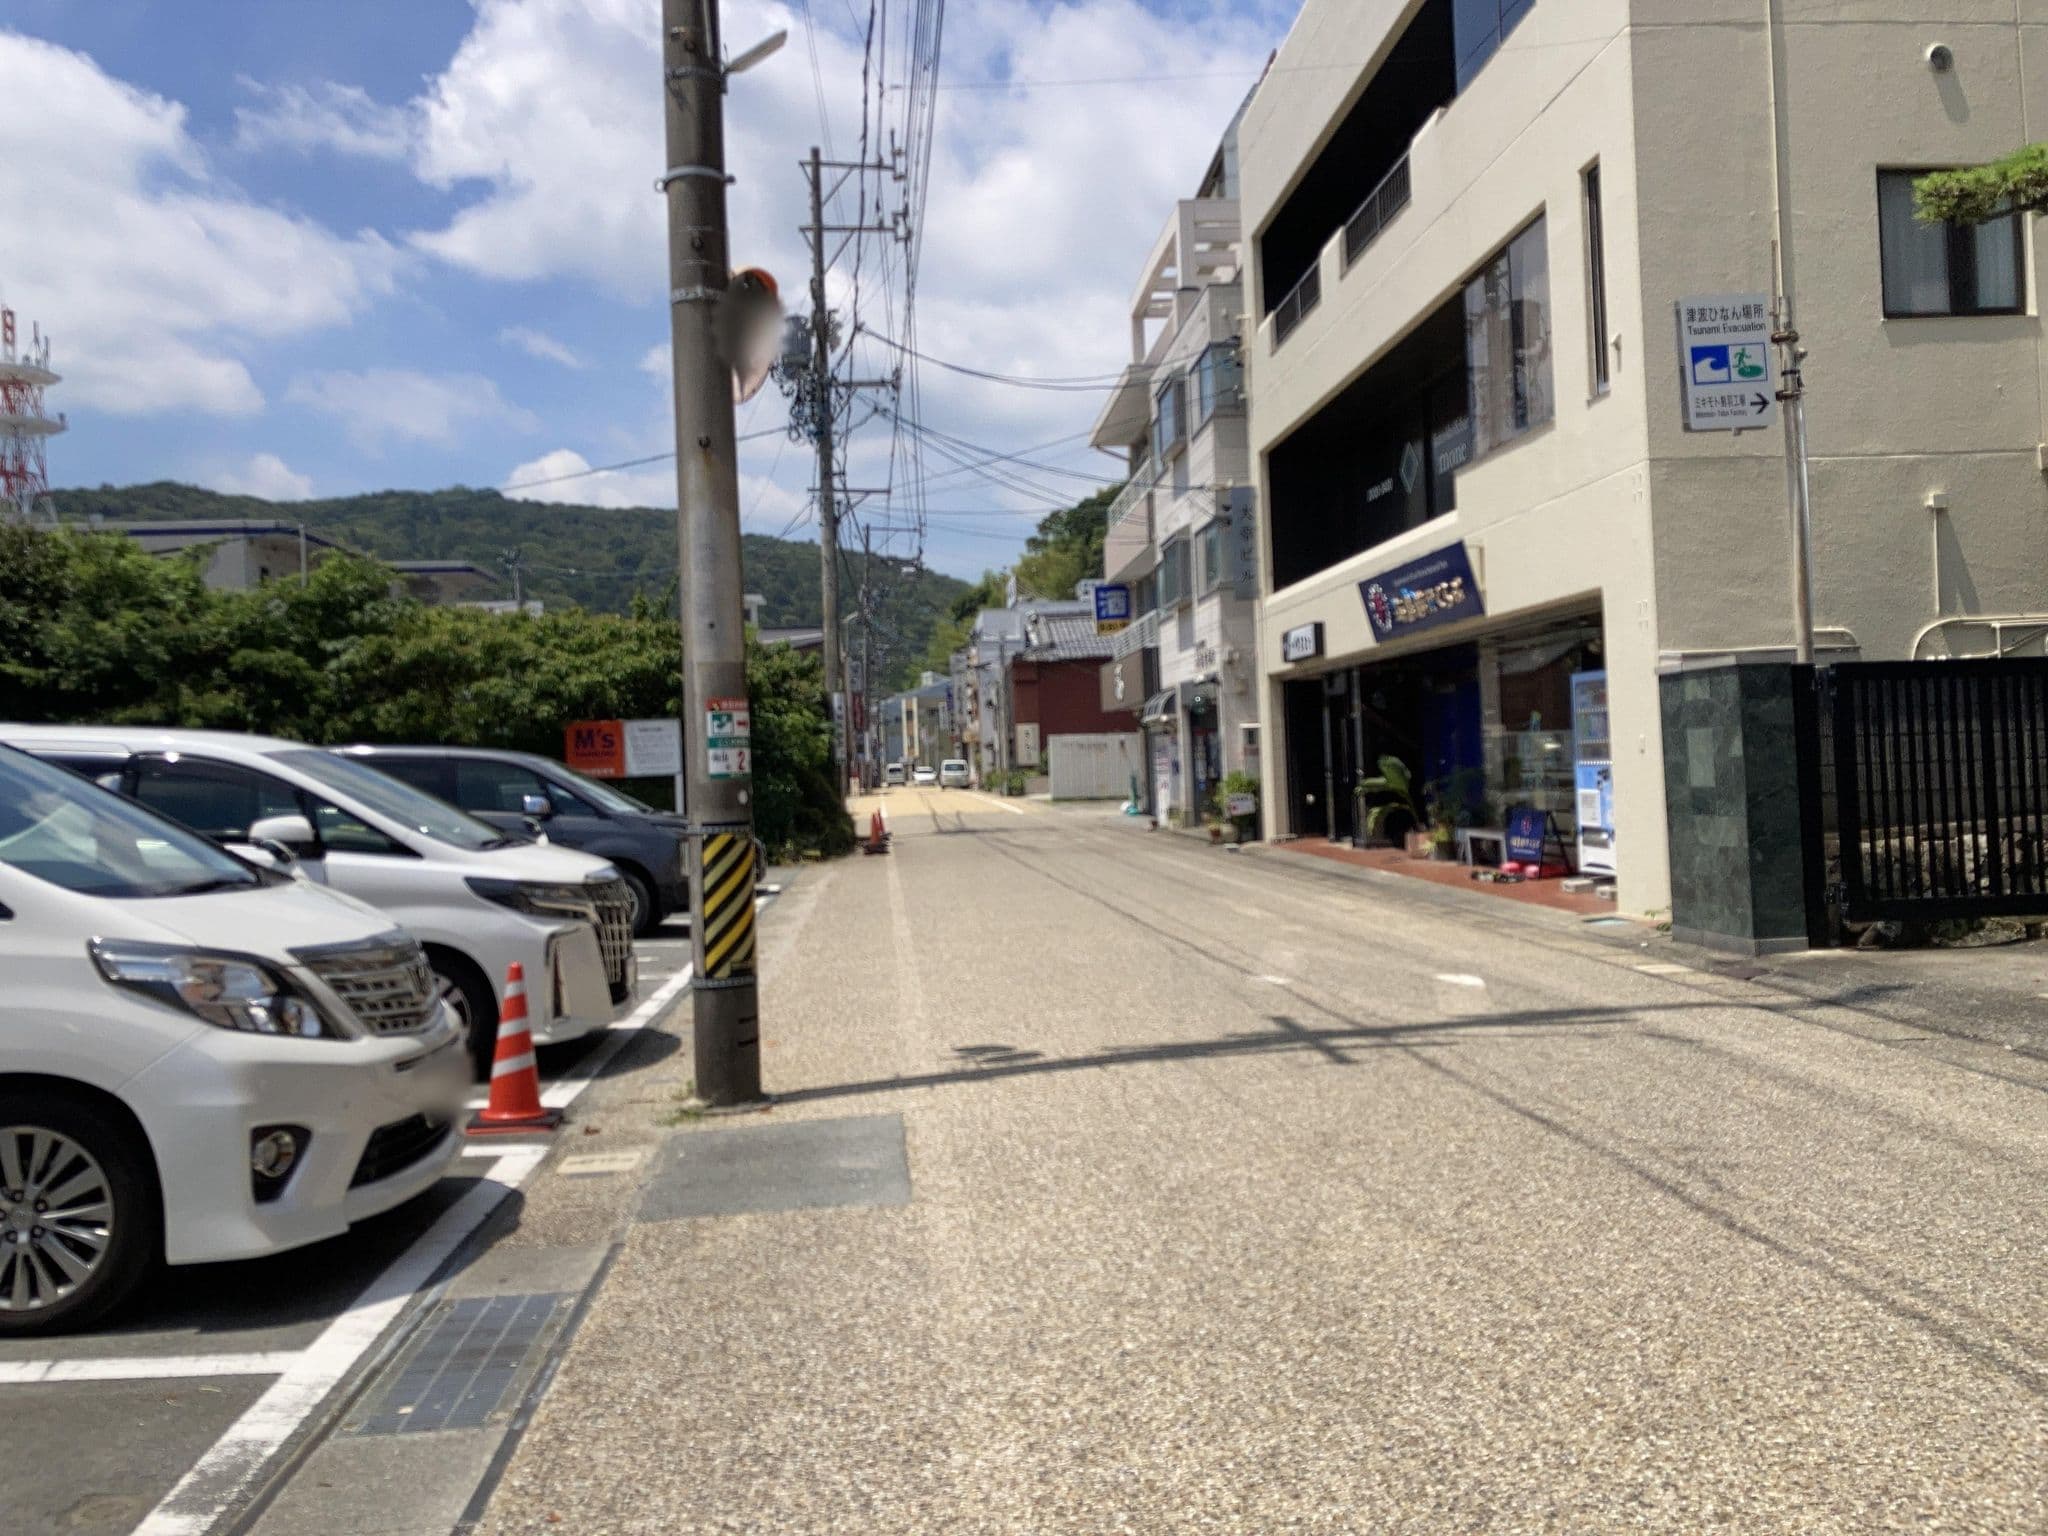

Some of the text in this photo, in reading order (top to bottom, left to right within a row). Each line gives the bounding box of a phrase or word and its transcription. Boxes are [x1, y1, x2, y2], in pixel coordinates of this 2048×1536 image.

[1686, 304, 1764, 322] 津波ひなん場所
[1687, 322, 1767, 336] Tsunami Evacuation
